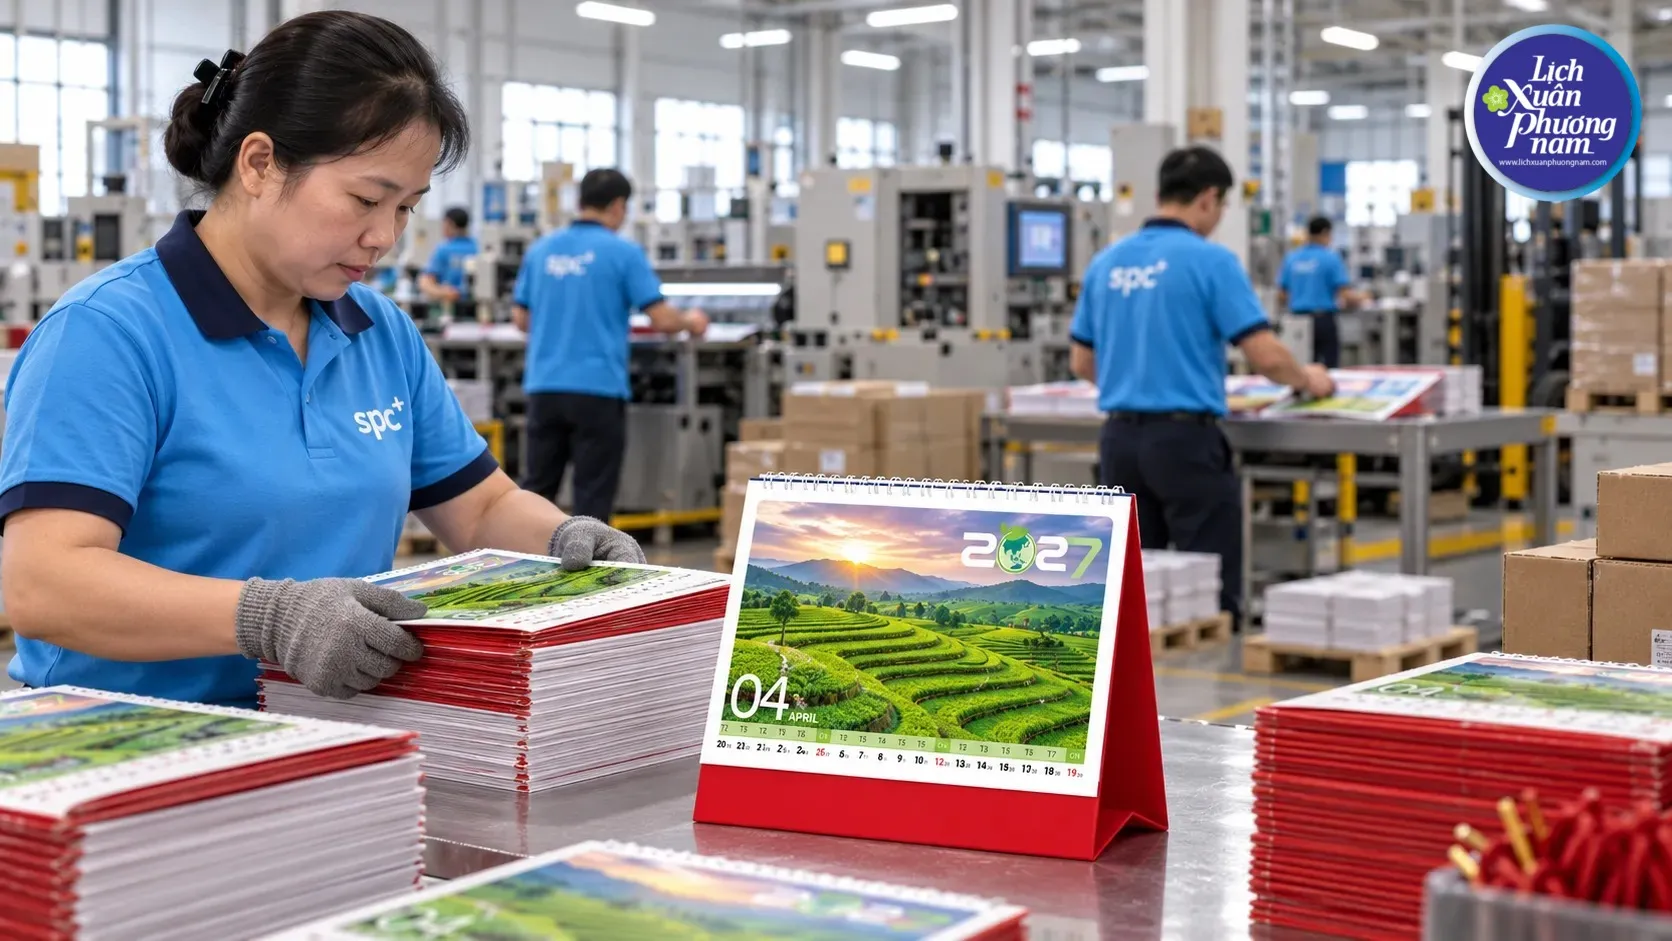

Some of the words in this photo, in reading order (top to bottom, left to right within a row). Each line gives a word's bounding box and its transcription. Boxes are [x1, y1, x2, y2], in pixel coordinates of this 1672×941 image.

[961, 524, 1103, 579] 2027
[730, 673, 790, 720] 04
[788, 711, 819, 723] APRIL
[914, 755, 924, 764] 10
[935, 757, 945, 767] 12
[955, 759, 966, 769] 13
[976, 760, 987, 770] 14
[1044, 766, 1055, 776] 18
[1067, 768, 1077, 777] 19
